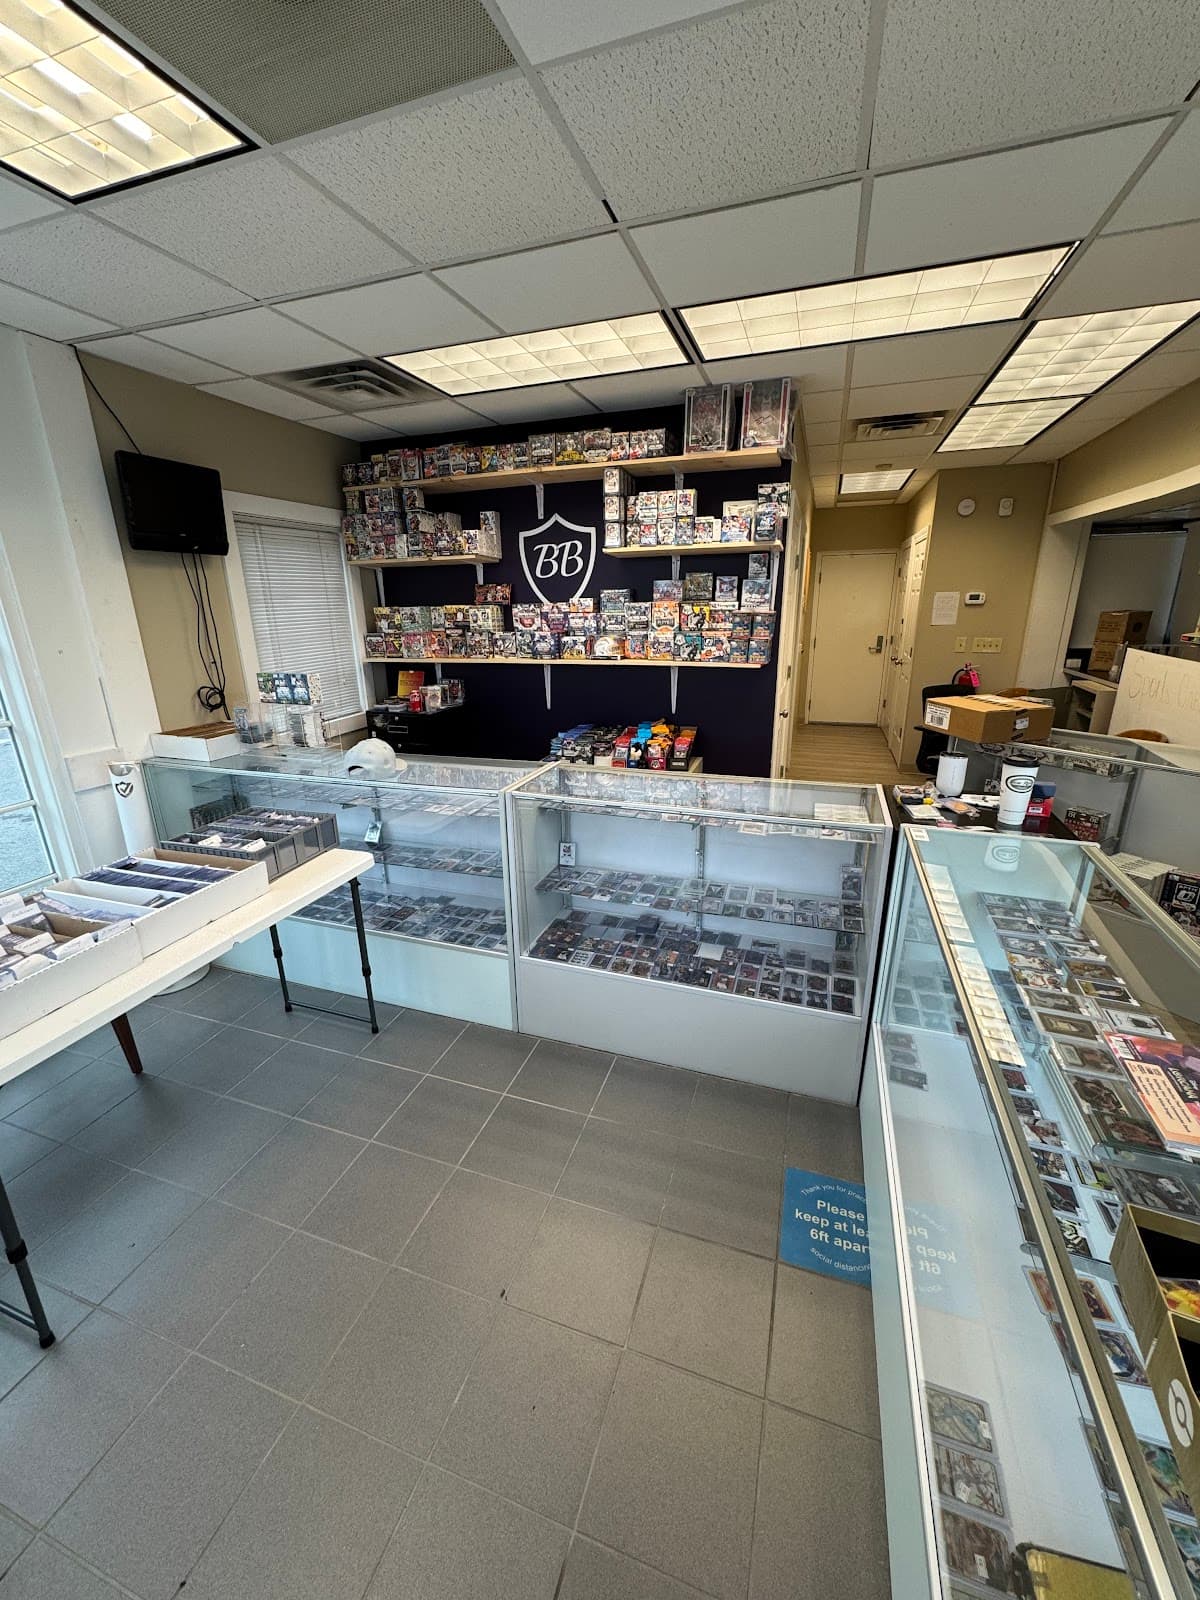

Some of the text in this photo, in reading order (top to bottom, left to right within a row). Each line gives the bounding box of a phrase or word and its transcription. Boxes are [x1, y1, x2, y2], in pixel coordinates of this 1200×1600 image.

[533, 540, 584, 578] BB
[801, 1184, 821, 1196] Thank
[836, 1185, 846, 1193] for
[847, 1190, 867, 1203] prac
[795, 1208, 830, 1228] keep
[834, 1221, 848, 1233] at
[816, 1199, 865, 1222] Please
[810, 1228, 869, 1254] 6ft apar
[809, 1247, 833, 1265] social
